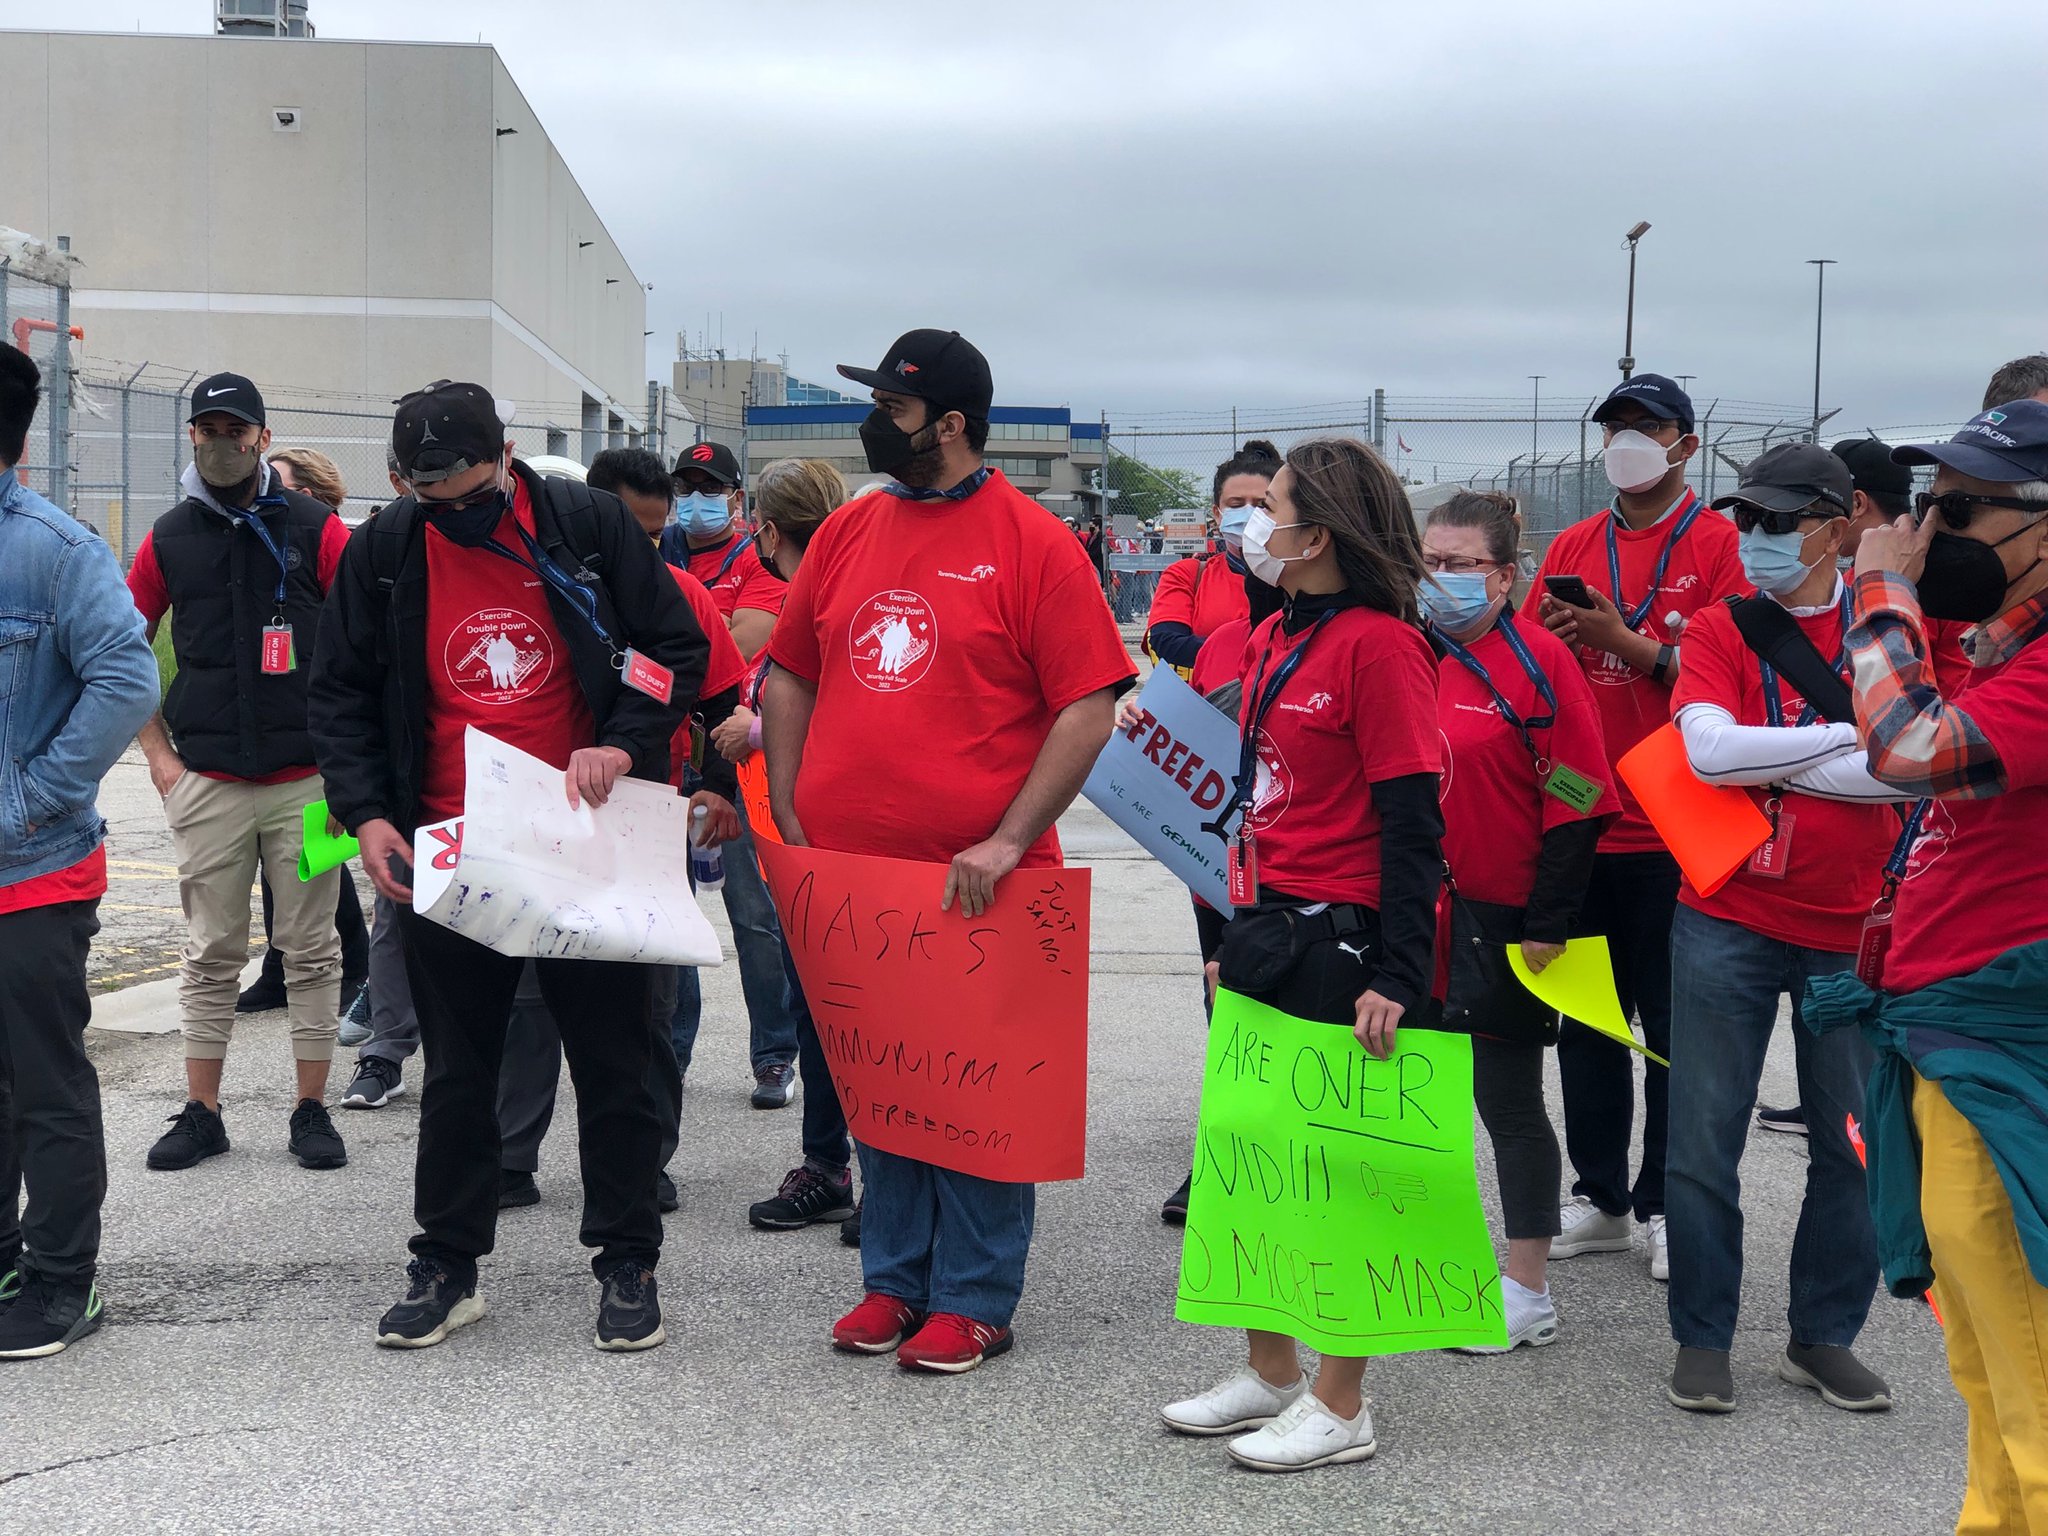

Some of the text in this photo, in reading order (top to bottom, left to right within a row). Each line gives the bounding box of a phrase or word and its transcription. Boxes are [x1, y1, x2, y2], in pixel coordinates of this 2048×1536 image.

[1979, 425, 2017, 447] PACIFIC
[937, 570, 977, 583] Toronto Pearson
[889, 592, 918, 603] Exercise
[480, 611, 512, 621] Exercise
[873, 602, 925, 615] Double Down
[466, 622, 527, 634] Double Down
[271, 637, 279, 669] NO DUFF
[634, 668, 647, 679] NO
[646, 675, 667, 690] DUFF
[866, 673, 884, 681] Security
[894, 676, 908, 684] Scale
[1294, 704, 1314, 714] Pearson
[1454, 703, 1494, 715] Toronto Pearson
[1255, 743, 1274, 754] Down
[1126, 708, 1226, 811] FREED
[1551, 782, 1586, 807] PARTICIPANT
[1559, 779, 1586, 800] EXERCISE
[1109, 779, 1126, 798] WE
[1131, 800, 1153, 821] ARE
[1160, 824, 1210, 868] GEMINI
[1253, 816, 1269, 824] Scale
[1762, 843, 1774, 868] DUFF
[1026, 900, 1054, 931] SAY
[1040, 881, 1076, 932] JUST
[1871, 935, 1881, 953] NO
[1217, 1022, 1439, 1130] ARE OVER
[872, 1102, 1012, 1154] FREEDOM
[1231, 1228, 1348, 1322] MORE
[1366, 1254, 1503, 1321] MASK
